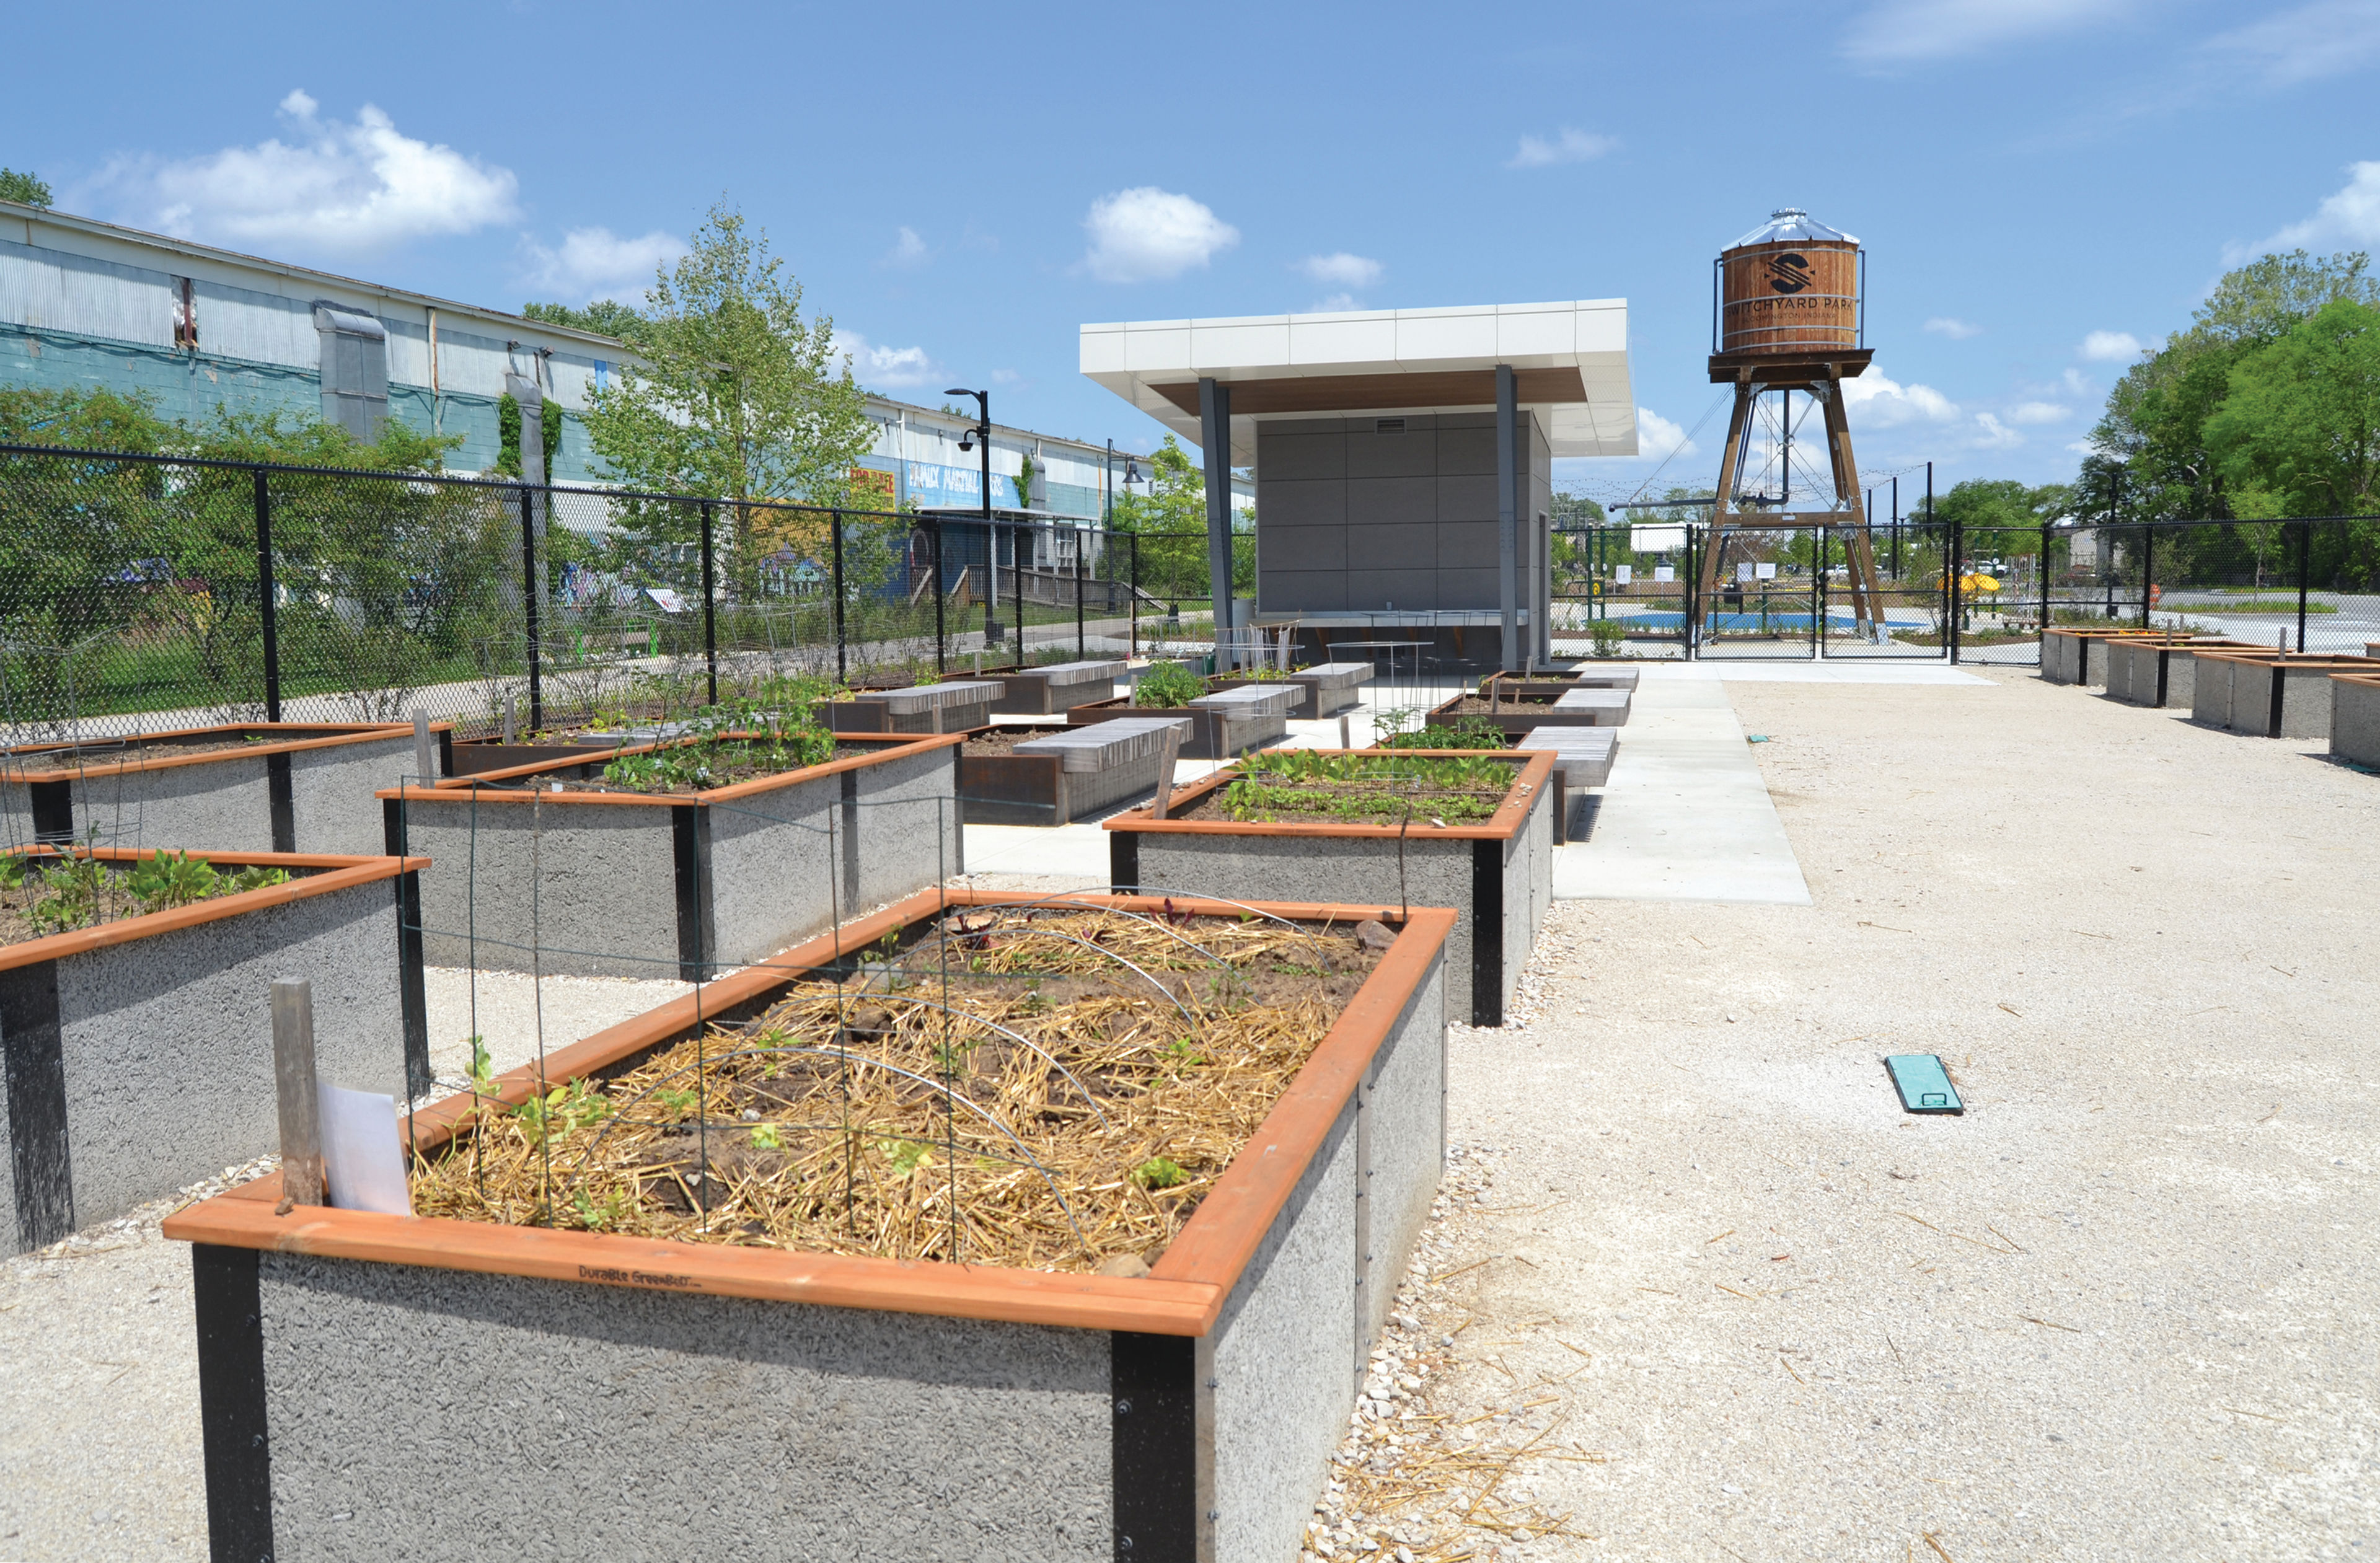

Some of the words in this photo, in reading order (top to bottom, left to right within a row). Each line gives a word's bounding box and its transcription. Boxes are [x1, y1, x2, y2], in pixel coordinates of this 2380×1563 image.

[1726, 297, 1818, 317] SWITCHYARD
[1823, 297, 1853, 311] PARK
[1742, 312, 1800, 323] BLOOMINGTON
[943, 467, 979, 494] MARTIAL
